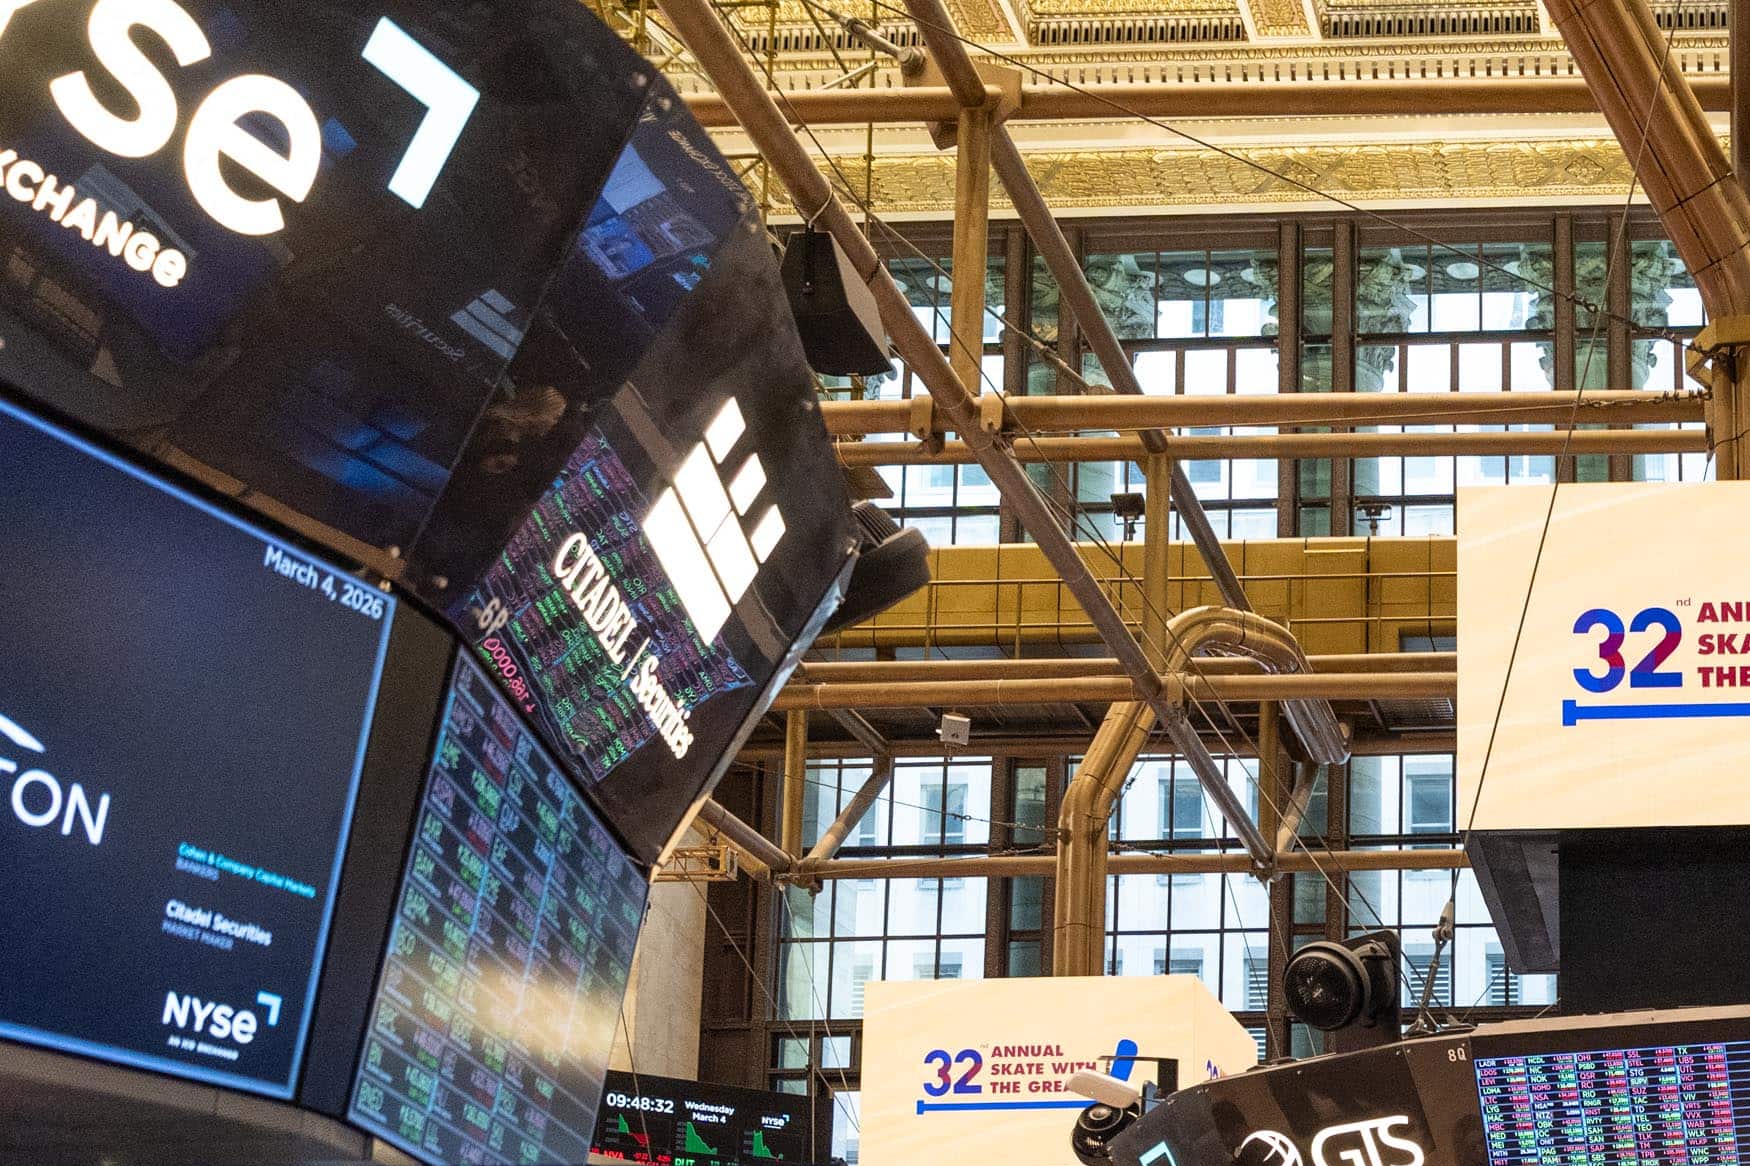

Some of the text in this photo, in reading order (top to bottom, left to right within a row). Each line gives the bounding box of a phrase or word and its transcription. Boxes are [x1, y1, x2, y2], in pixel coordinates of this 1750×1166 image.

[264, 544, 384, 620] March 4, 2026
[553, 531, 695, 760] CITADEL Securities
[1572, 596, 1692, 694] 32 nd
[0, 758, 111, 846] ON
[990, 1045, 1064, 1058] ANNUAL
[1448, 1047, 1467, 1062] 8Q
[923, 1049, 983, 1097] 32
[990, 1063, 1044, 1076] SKATE
[990, 1081, 1021, 1095] THE
[606, 1092, 675, 1114] 09:48:32
[684, 1100, 735, 1116] Wednesday
[692, 1112, 727, 1124] March 4
